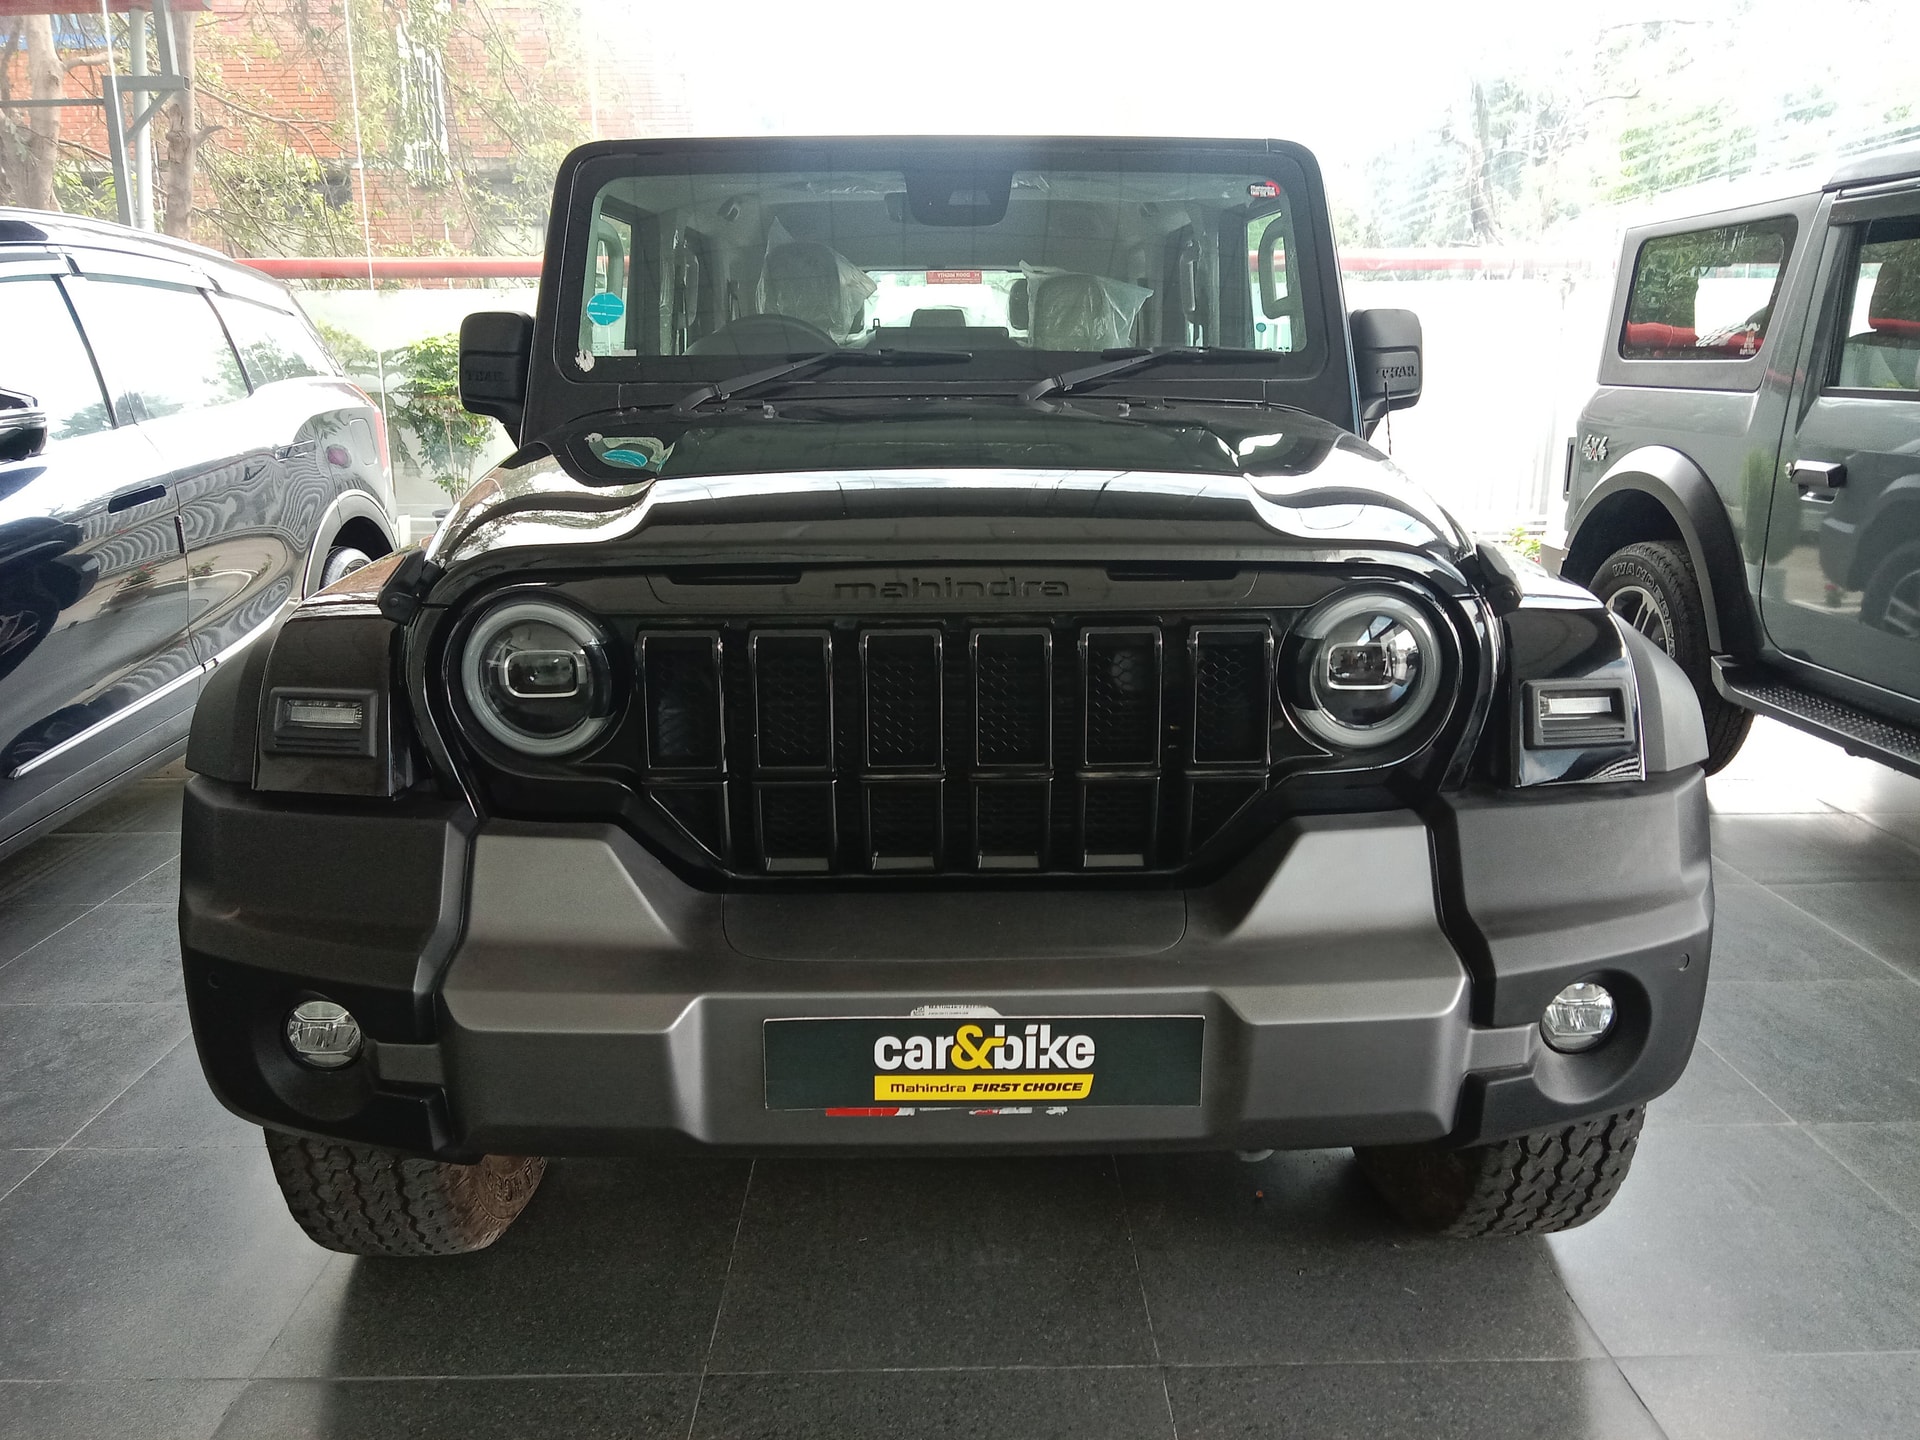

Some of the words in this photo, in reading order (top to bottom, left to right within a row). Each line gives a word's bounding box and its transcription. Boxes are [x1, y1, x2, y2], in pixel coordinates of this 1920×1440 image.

[835, 576, 1069, 598] mahindra
[874, 1024, 1095, 1070] car&bike
[890, 1083, 967, 1094] Mahindra
[972, 1082, 1020, 1093] FIRST
[1022, 1082, 1083, 1092] CHOICE
